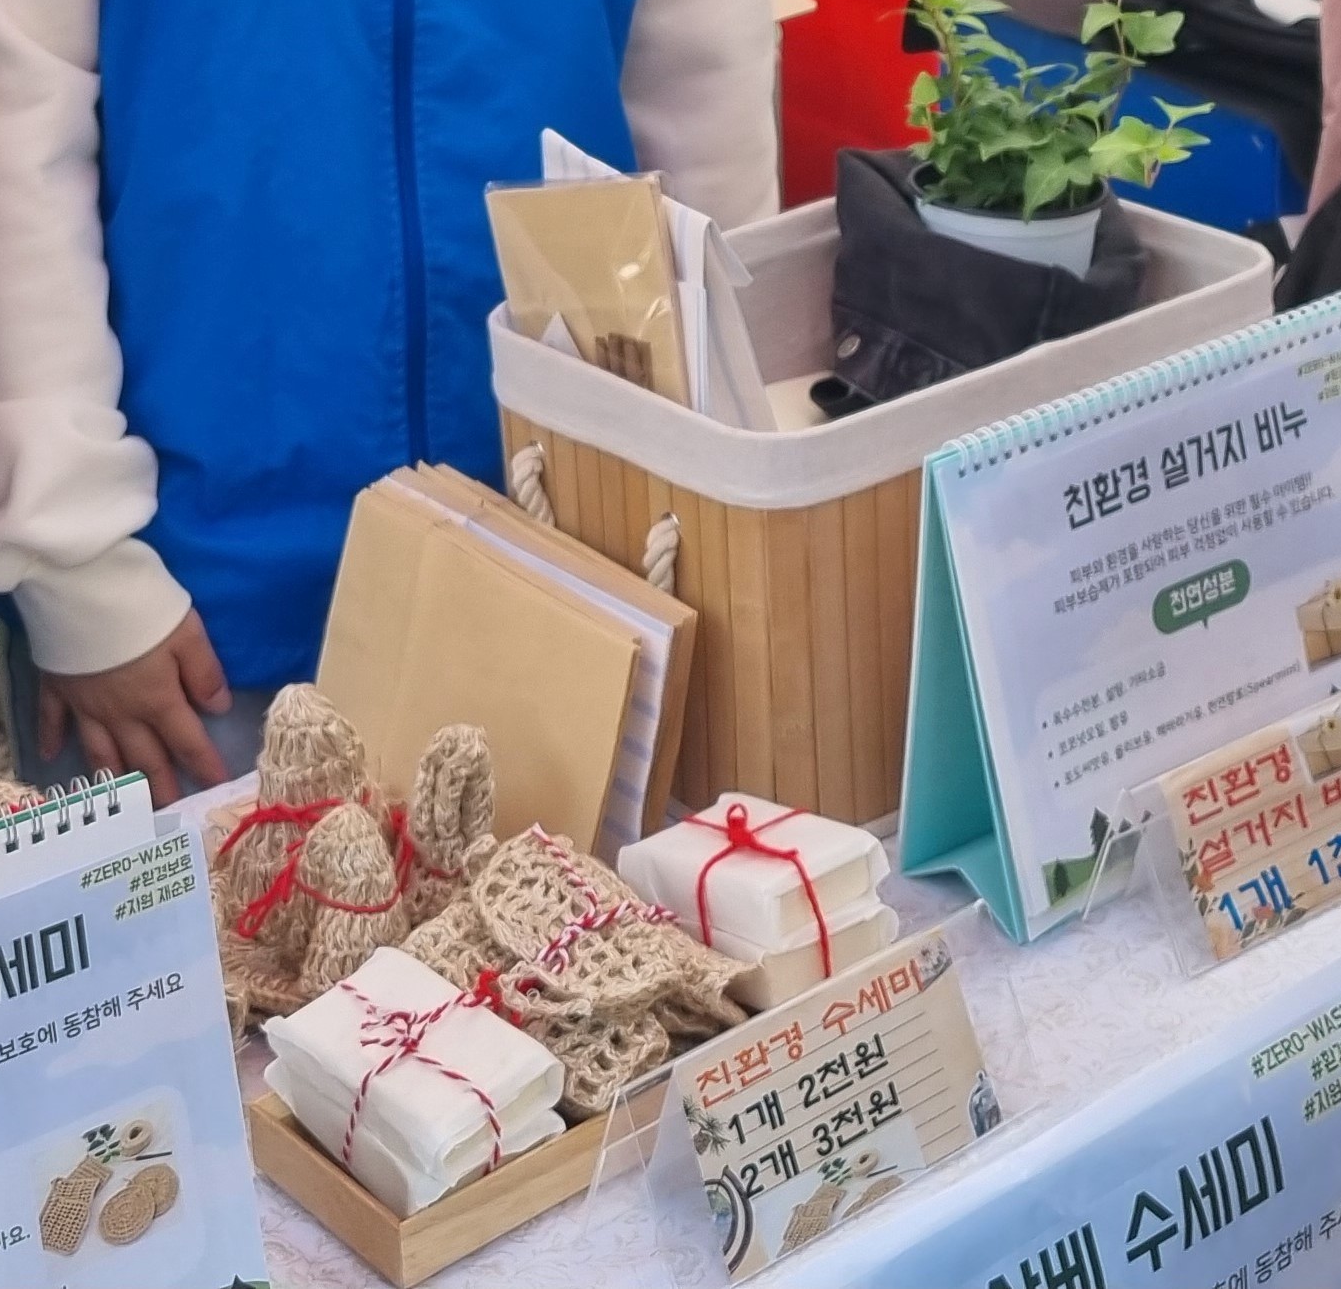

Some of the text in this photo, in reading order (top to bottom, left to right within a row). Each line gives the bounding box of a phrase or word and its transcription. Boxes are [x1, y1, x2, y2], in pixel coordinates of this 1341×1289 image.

[1064, 401, 1308, 529] 친환경 설거지 비누
[1186, 508, 1222, 534] 당신을
[1224, 498, 1247, 519] 위한
[1276, 503, 1288, 519] 수
[1168, 567, 1237, 619] 천연성분
[80, 832, 190, 889] #ZERO-WASTE
[1198, 793, 1309, 875] 설거지
[129, 853, 193, 892] #환경보호
[1218, 864, 1293, 931] 1개
[62, 994, 123, 1040] 동참해
[127, 971, 186, 1013] 주세요
[821, 958, 926, 1036] 수세미
[728, 1089, 787, 1145] 1개
[740, 1139, 801, 1199] 2개
[1125, 1114, 1287, 1273] 수세미
[1254, 1222, 1313, 1285] 동참해
